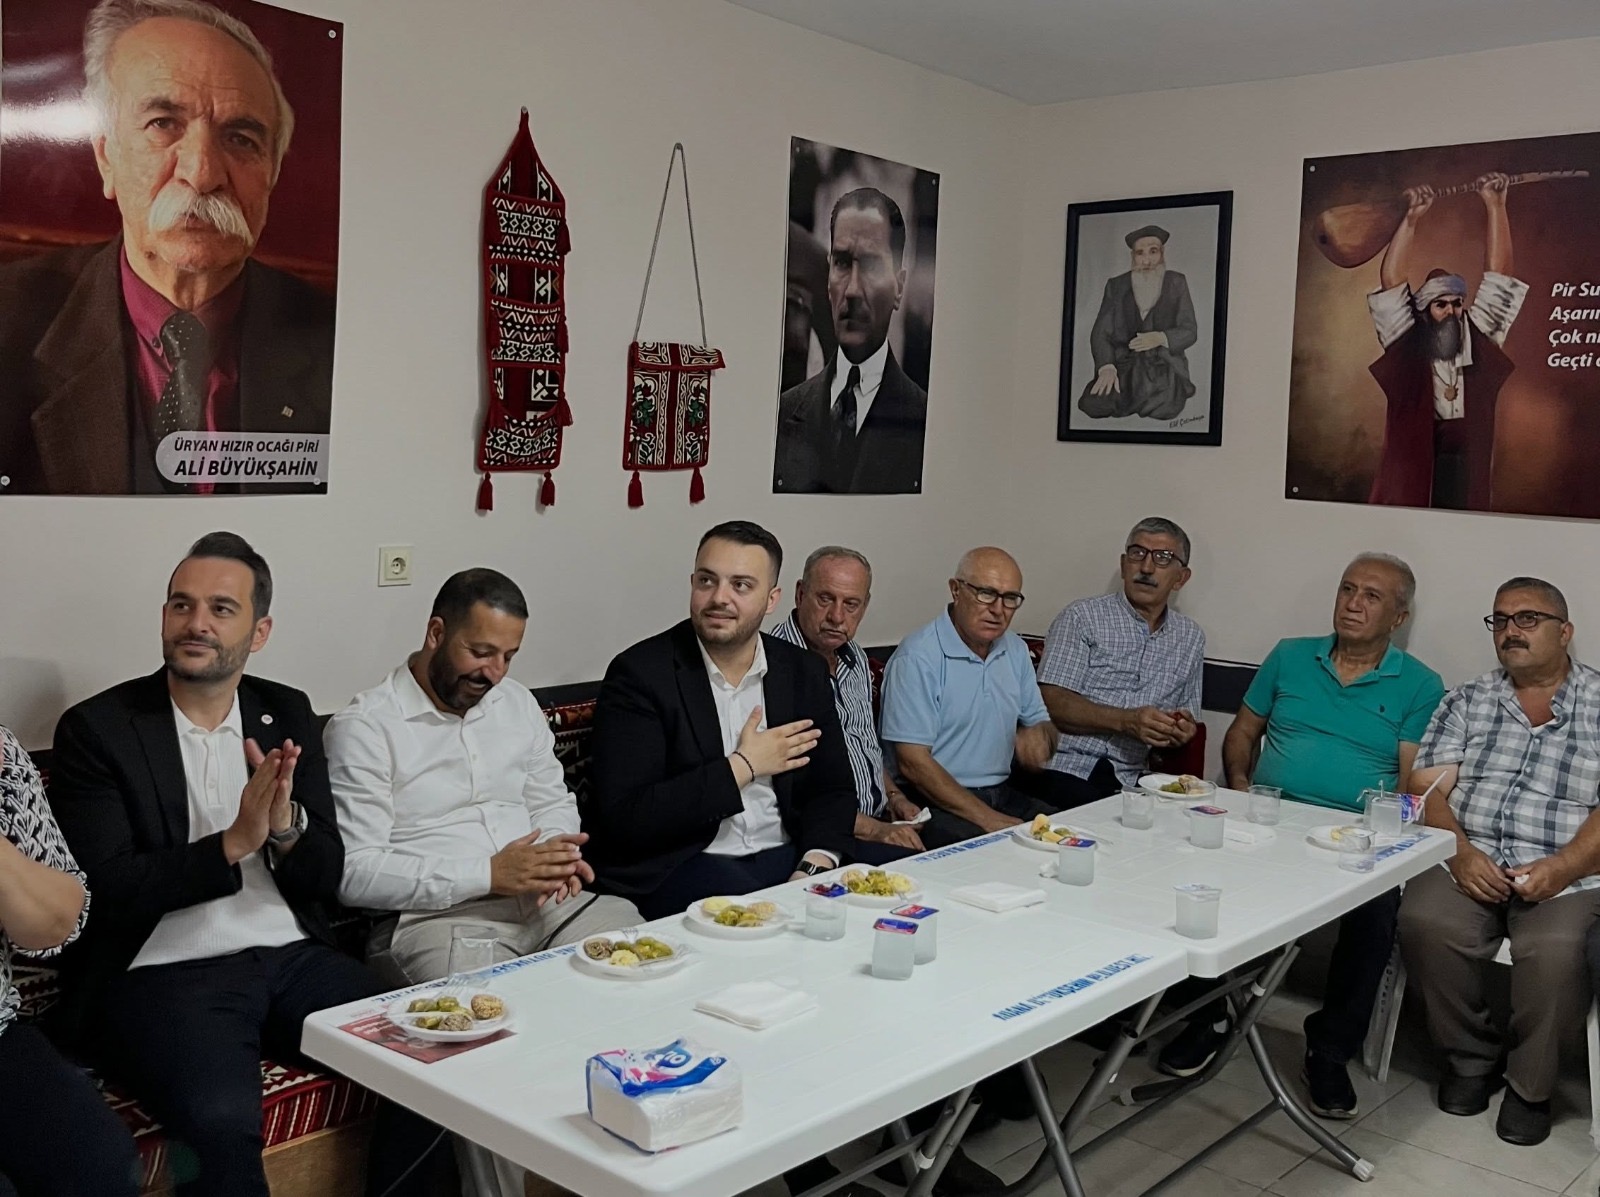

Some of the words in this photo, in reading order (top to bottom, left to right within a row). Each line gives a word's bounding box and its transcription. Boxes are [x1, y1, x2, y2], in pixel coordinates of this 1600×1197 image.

[1551, 282, 1577, 297] Pir
[1548, 329, 1583, 348] Çok
[1547, 352, 1594, 371] Geçti
[174, 437, 219, 451] ÜRYAN
[220, 440, 254, 452] HIZIR
[256, 439, 295, 453] OCAĞI
[296, 439, 320, 453] PİRİ
[174, 456, 206, 476] ALİ
[207, 456, 318, 479] BÜYÜKŞAHİN
